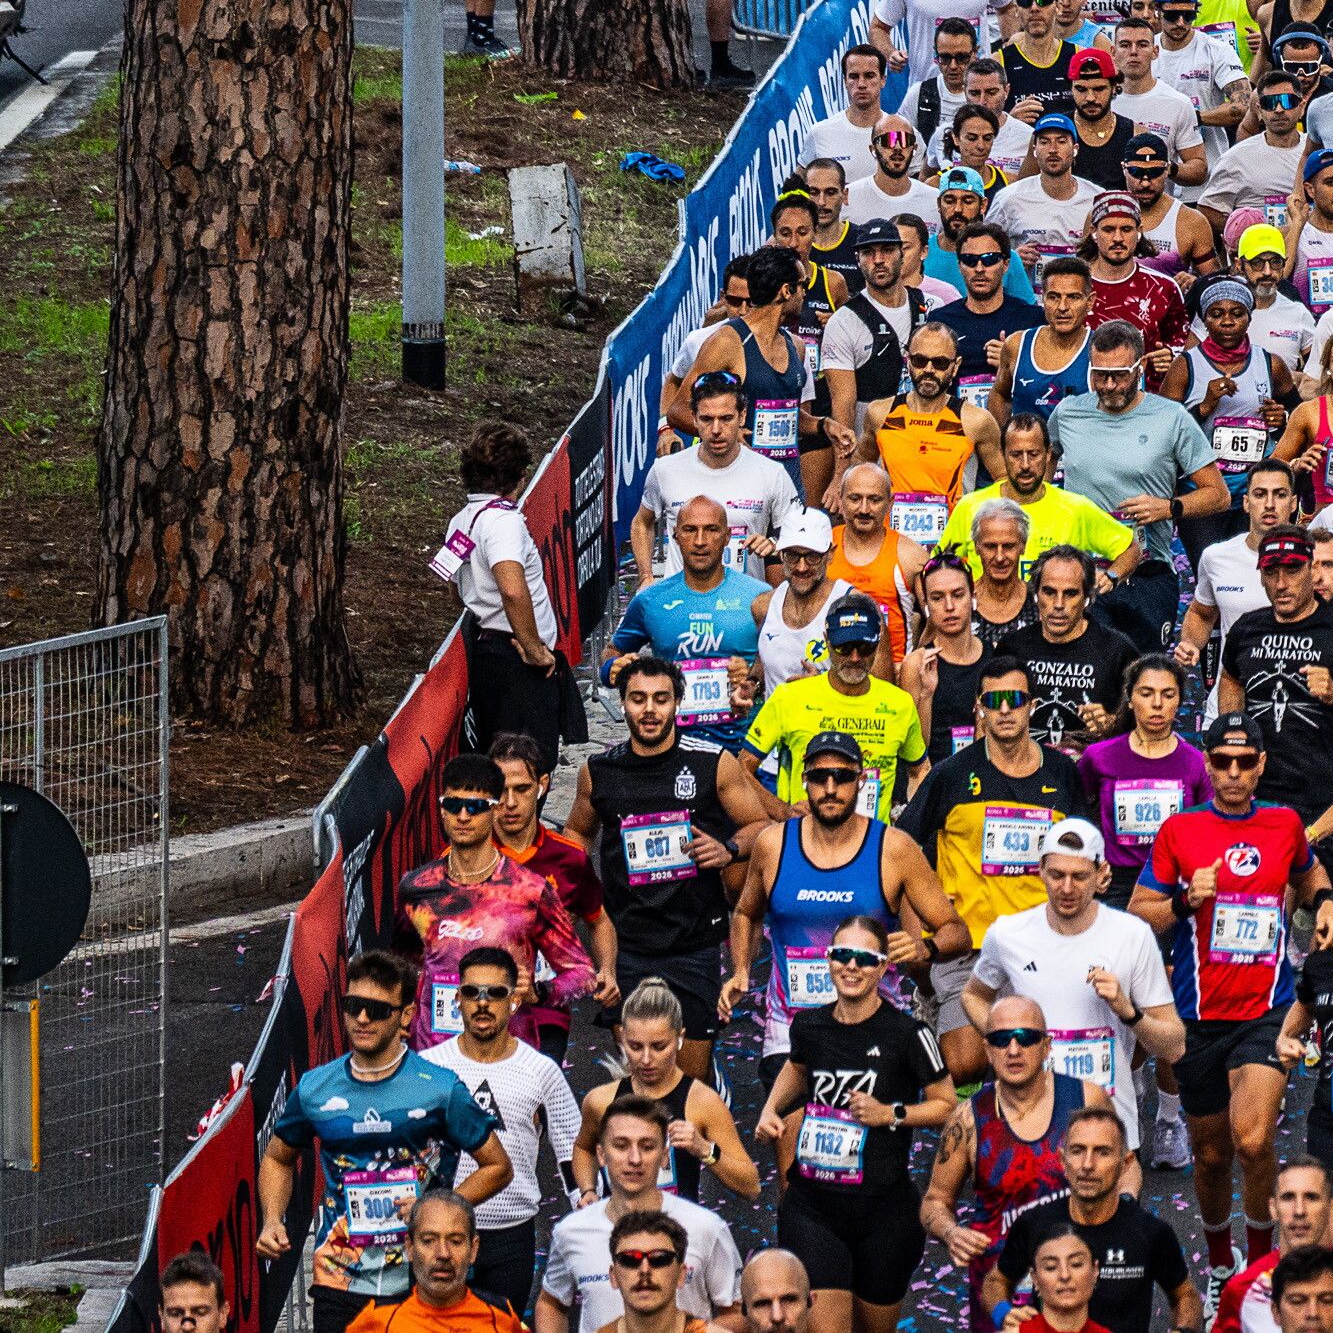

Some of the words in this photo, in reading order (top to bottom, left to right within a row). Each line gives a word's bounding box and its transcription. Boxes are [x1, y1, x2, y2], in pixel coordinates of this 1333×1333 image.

[1231, 435, 1249, 453] 65
[1216, 585, 1244, 593] BROOKS
[689, 621, 714, 636] FUN
[678, 631, 725, 656] RUN
[1261, 635, 1313, 650] QUINO
[1269, 645, 1322, 662] MARATÓN
[1026, 659, 1095, 677] GONZALO
[1038, 673, 1096, 690] MARATÓN
[837, 717, 886, 731] GENERALI
[1134, 802, 1162, 823] 926
[1003, 832, 1030, 852] 433
[650, 870, 673, 880] 2026
[1002, 865, 1025, 875] 2026
[796, 889, 855, 903] BROOKS
[1235, 919, 1259, 940] 772
[1231, 953, 1254, 964] 2026
[1062, 1055, 1094, 1076] 1119
[814, 1132, 843, 1156] 1132
[815, 1170, 836, 1180] 2026
[373, 1233, 398, 1244] 2026
